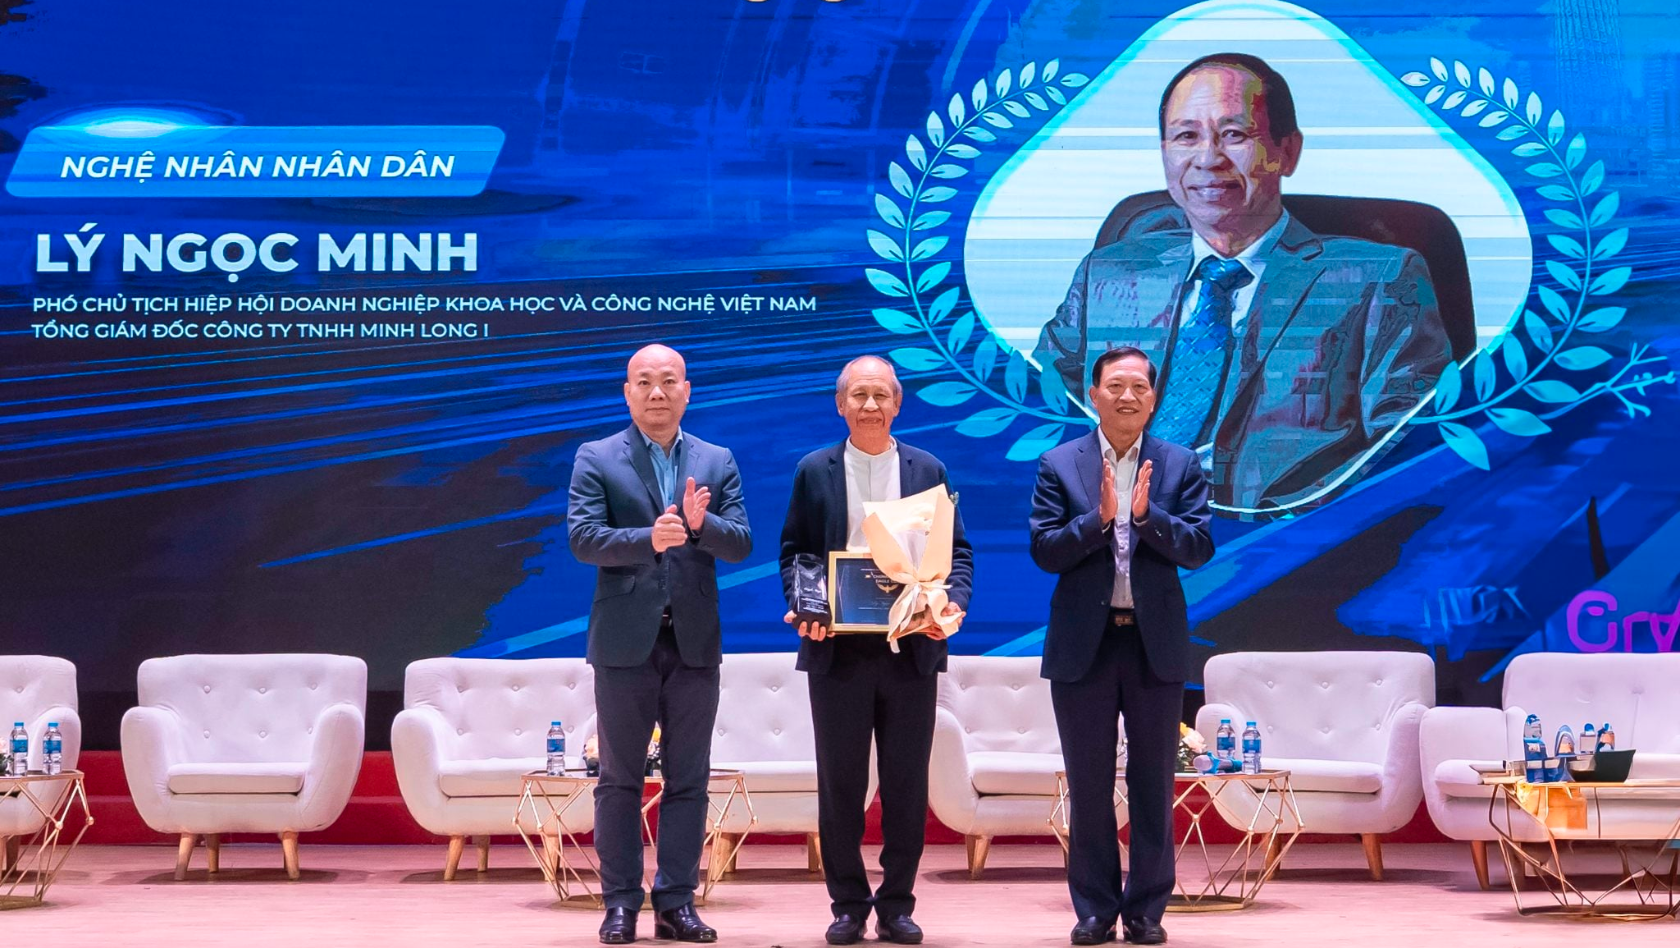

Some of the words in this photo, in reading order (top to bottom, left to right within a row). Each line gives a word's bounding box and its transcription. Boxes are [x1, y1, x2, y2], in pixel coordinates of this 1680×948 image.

[60, 151, 156, 183] NGHỆ
[164, 151, 264, 178] NHÂN
[272, 150, 372, 177] NHÂN
[380, 150, 455, 177] DÂN
[36, 222, 106, 272] LÝ
[122, 232, 299, 283] NGỌC
[318, 233, 478, 271] MINH
[33, 294, 78, 312] PHÓ
[83, 293, 127, 312] CHỦ
[131, 297, 178, 315] TỊCH
[184, 294, 232, 315] HIỆP
[238, 294, 274, 315] HỘI
[280, 297, 356, 312] DOANH
[362, 294, 440, 315] NGHIỆP
[446, 297, 505, 312] KHOA
[510, 296, 555, 315] HỌC
[559, 294, 588, 311] VÀ
[592, 294, 652, 311] CÔNG
[658, 294, 716, 315] NGHỆ
[720, 294, 765, 315] VIỆT
[769, 296, 816, 311] NAM
[31, 319, 89, 338] TỔNG
[94, 320, 147, 338] GIÁM
[151, 319, 199, 338] ĐỐC
[203, 320, 263, 338] CÔNG
[267, 323, 293, 338] TY
[296, 323, 354, 338] TNHH
[360, 323, 415, 338] MINH
[421, 323, 478, 338] LONG
